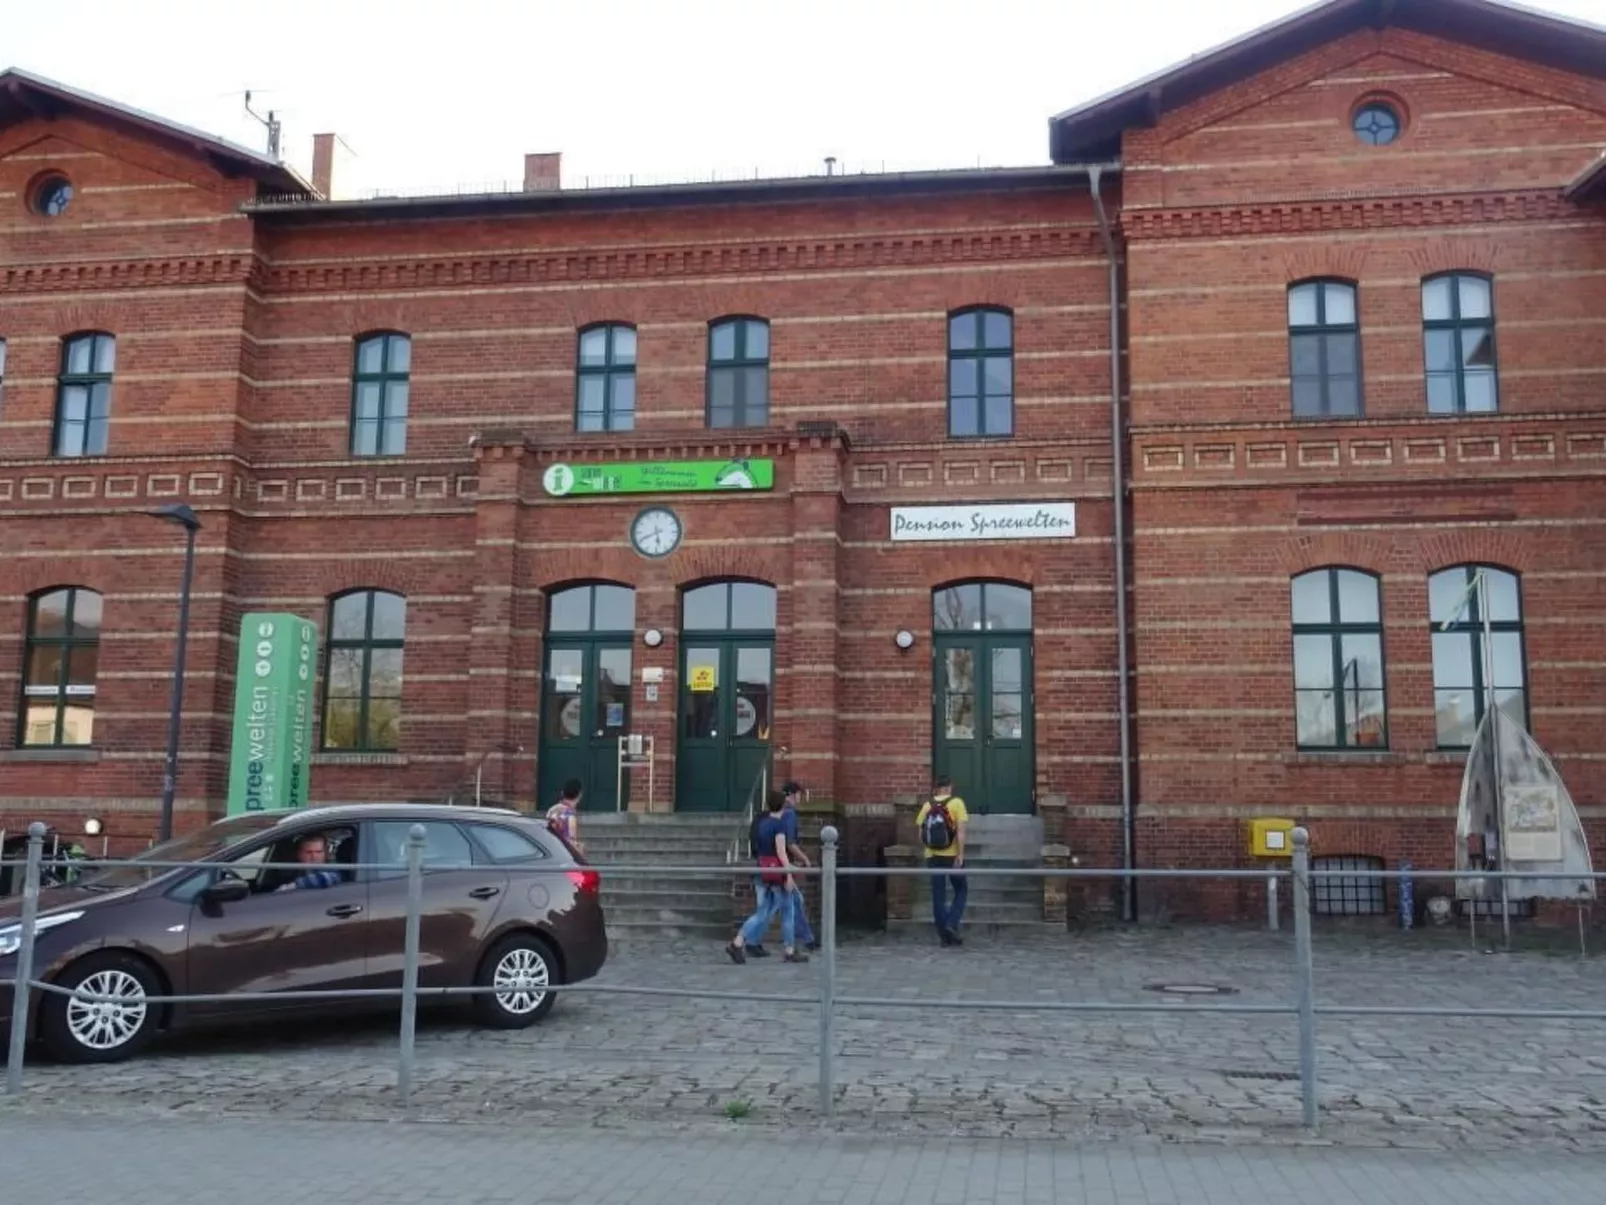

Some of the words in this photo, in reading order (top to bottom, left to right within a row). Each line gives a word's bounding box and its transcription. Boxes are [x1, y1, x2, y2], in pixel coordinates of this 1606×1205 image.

[895, 513, 964, 535] Pension
[970, 509, 1071, 535] Spreewelten
[245, 686, 269, 811] preewelten
[288, 689, 306, 807] reewelten
